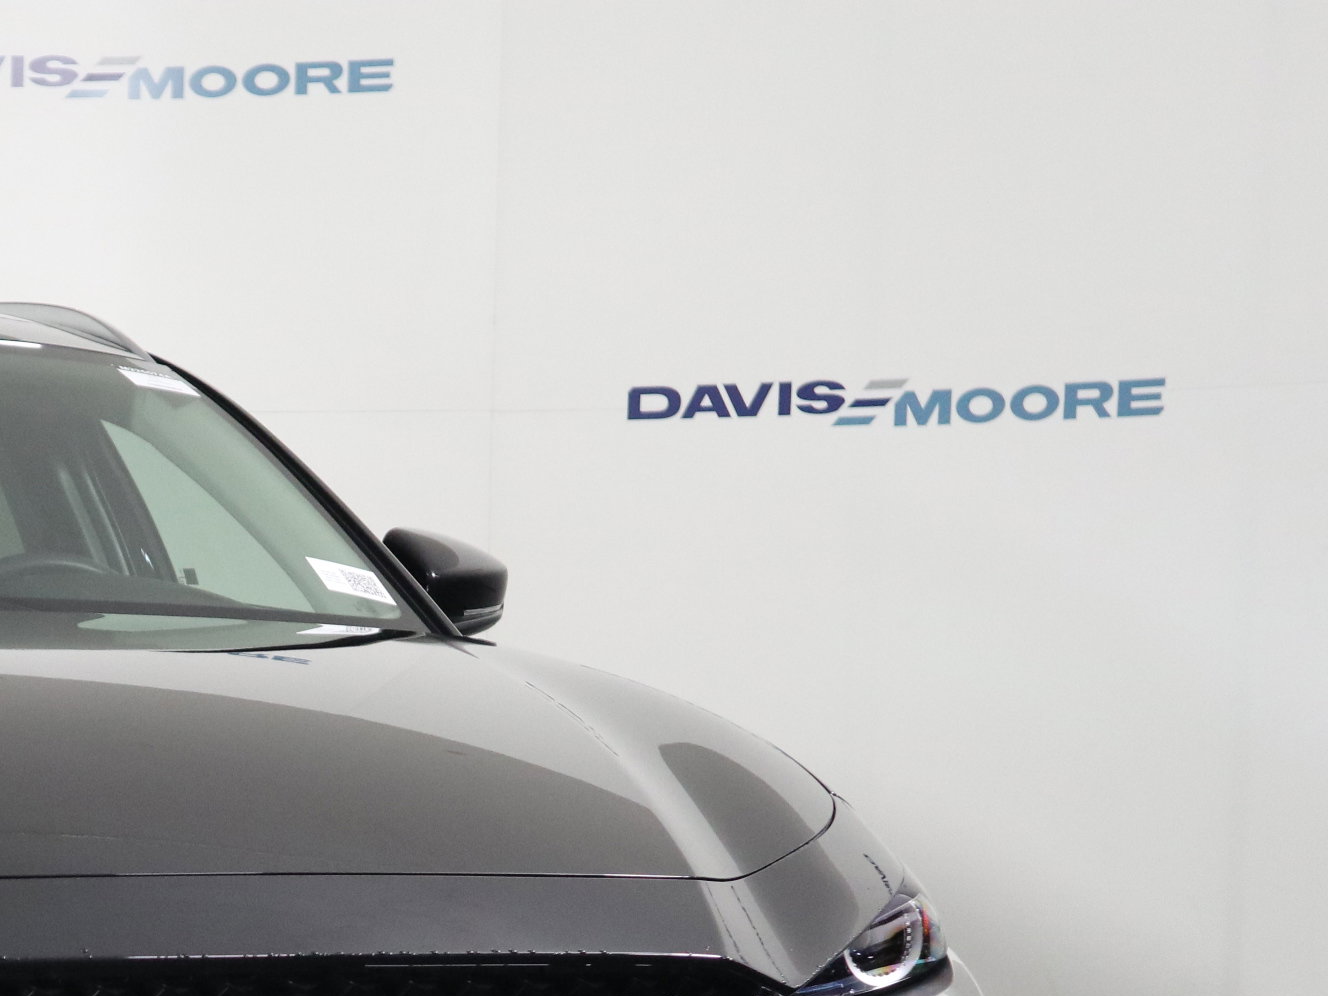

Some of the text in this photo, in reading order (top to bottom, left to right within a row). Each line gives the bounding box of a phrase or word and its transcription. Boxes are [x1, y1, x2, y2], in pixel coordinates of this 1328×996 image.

[127, 58, 394, 99] MOORE
[627, 378, 1166, 426] DAVIS MOORE
